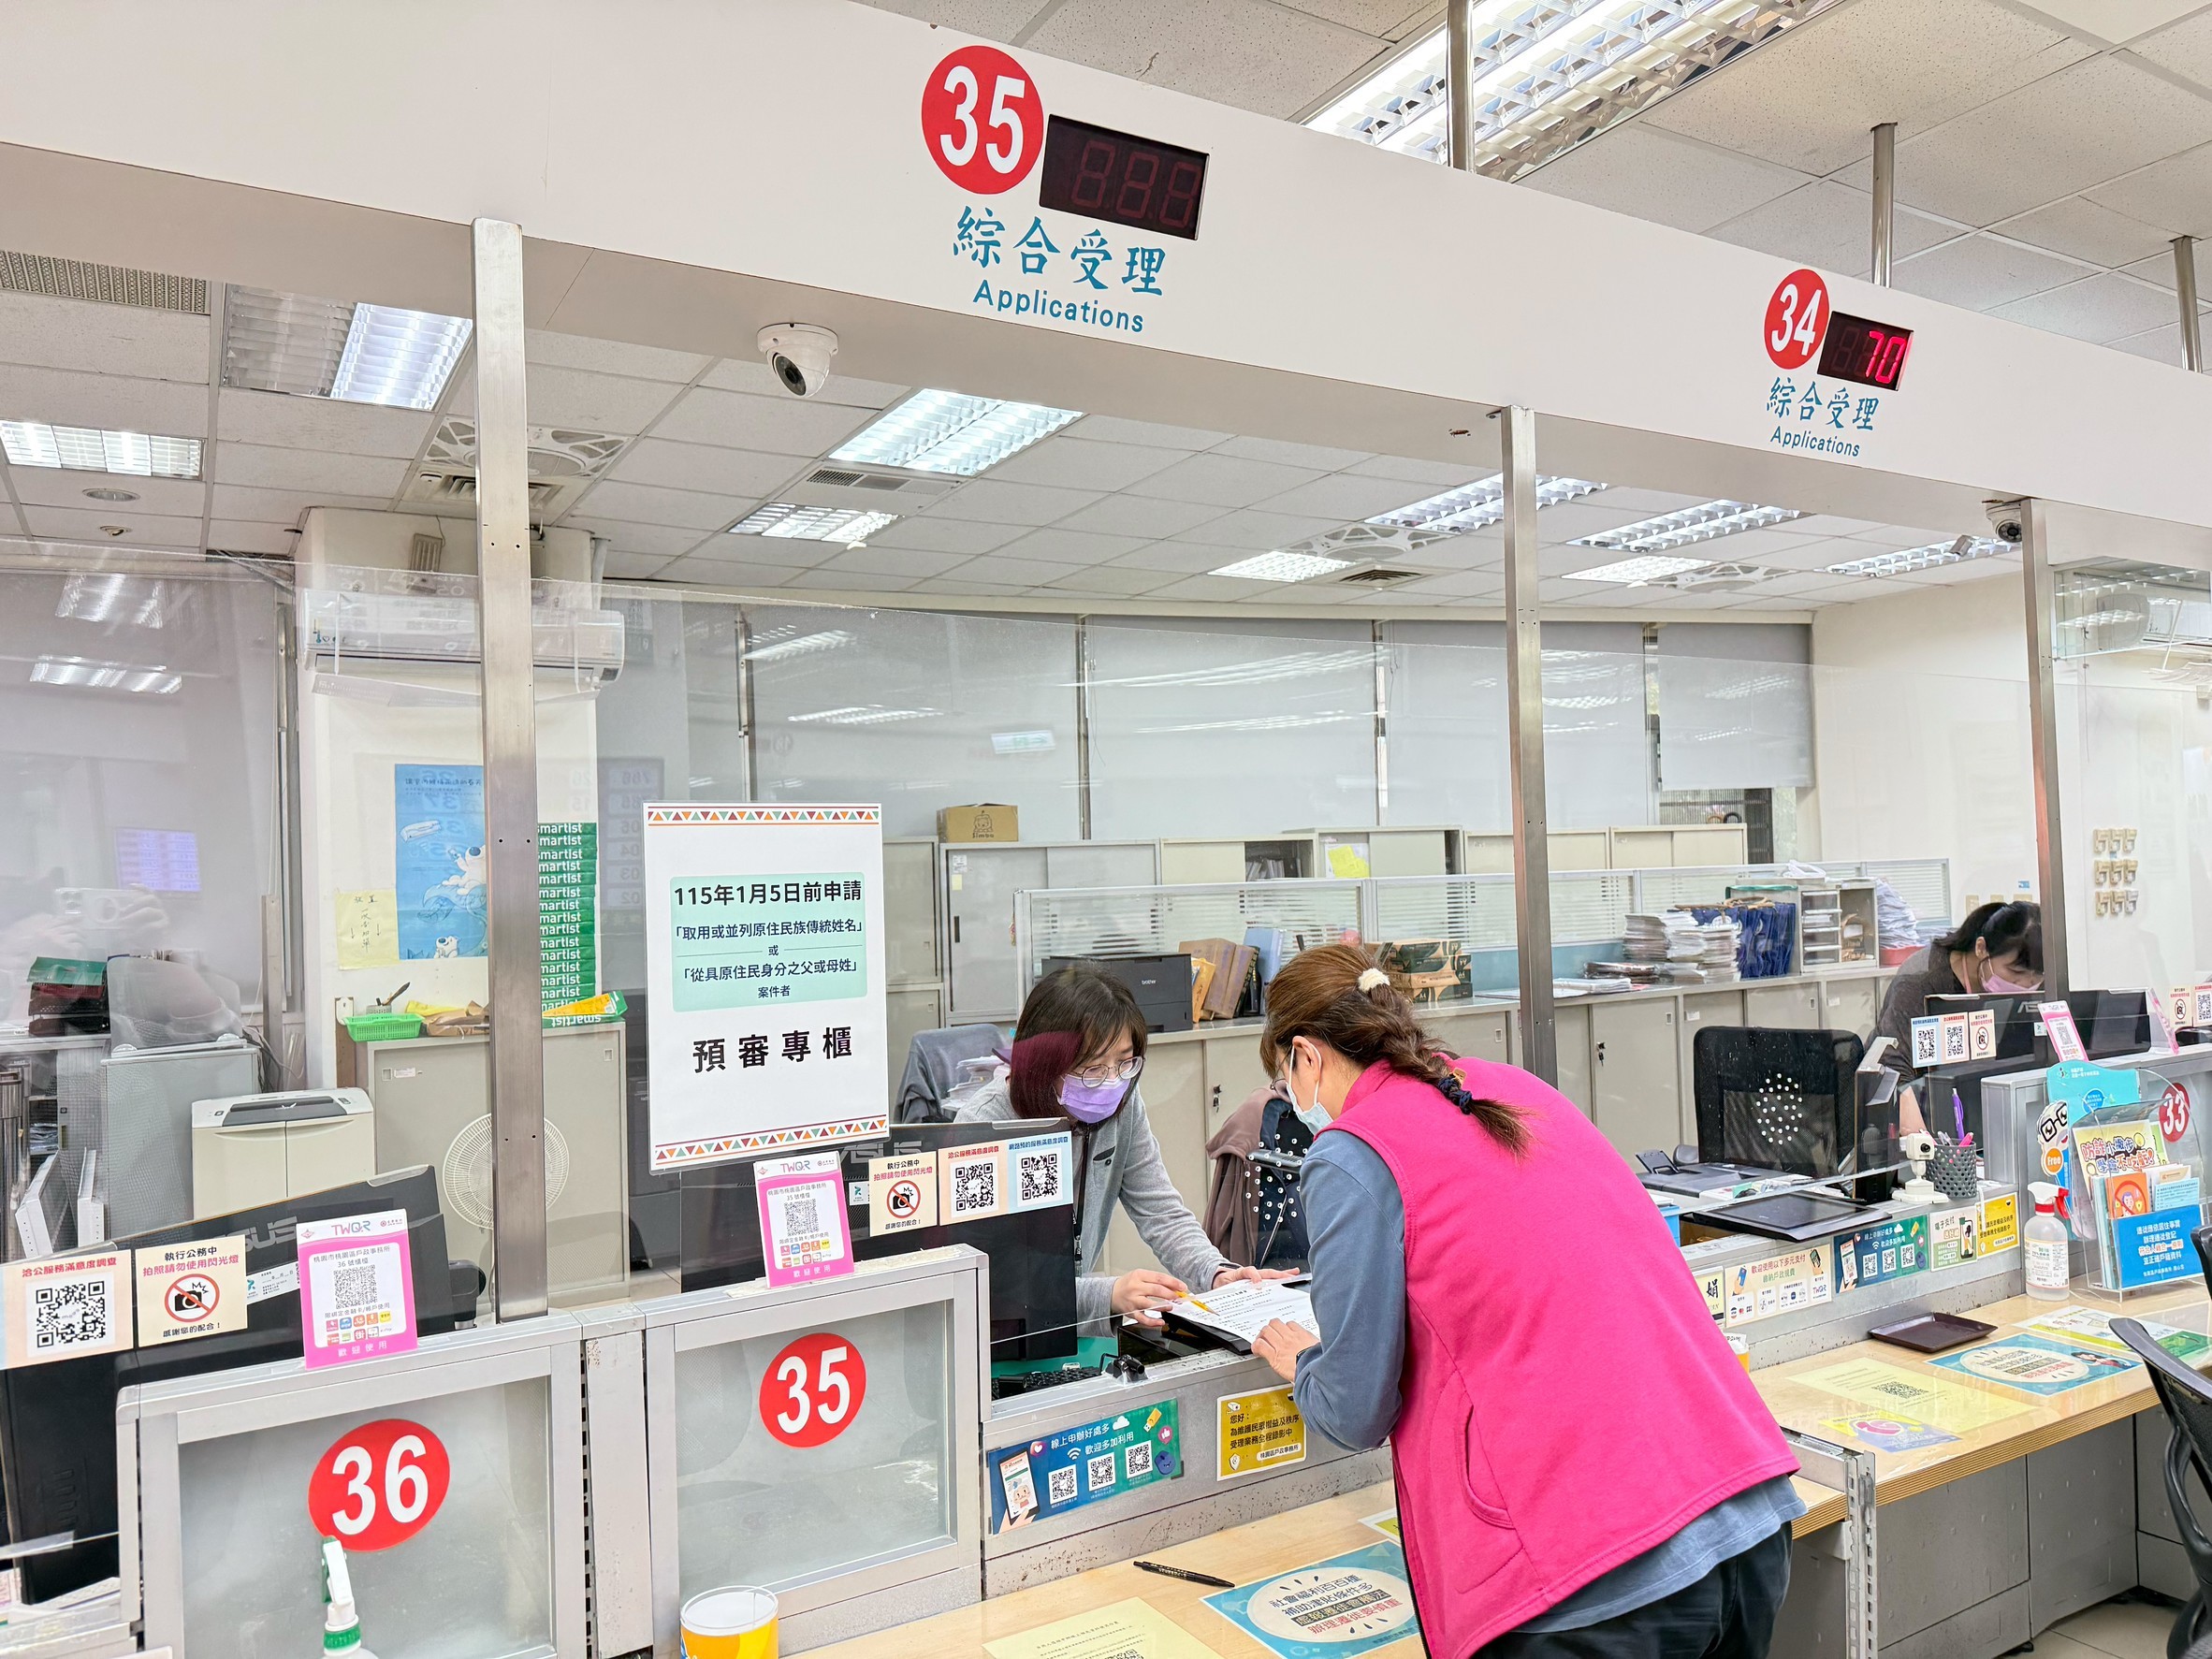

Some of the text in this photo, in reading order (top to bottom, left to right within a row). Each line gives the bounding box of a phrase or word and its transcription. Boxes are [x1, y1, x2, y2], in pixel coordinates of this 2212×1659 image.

[939, 65, 1026, 174] 35
[953, 205, 1166, 296] 綜合受理
[973, 279, 1144, 332] Applications
[1770, 283, 1822, 356] 34
[1865, 330, 1908, 384] 70
[1766, 376, 1880, 430] 綜合受理
[1770, 425, 1860, 457] Applications
[539, 835, 582, 846] martist
[539, 860, 581, 873] martist
[539, 872, 581, 884] martist
[539, 886, 581, 898] martist
[674, 880, 862, 906] 115年1月5日前申請
[539, 898, 580, 910] martist
[539, 910, 581, 924] martist
[540, 923, 580, 936] martist
[676, 918, 863, 940] 「取用或並列原住民族傳統姓名」
[540, 935, 580, 948] martist
[767, 945, 779, 956] 或
[541, 947, 581, 960] martist
[541, 960, 580, 973] martist
[683, 957, 857, 982] 「從具原住民身分之父或母姓」
[541, 973, 580, 986] martist
[541, 985, 580, 998] martist
[757, 985, 791, 998] 案件者
[692, 1026, 852, 1074] 預審專櫃
[2162, 1089, 2187, 1137] 33
[2047, 1156, 2061, 1166] Free
[217, 1216, 298, 1252] SUS
[331, 1220, 371, 1236] TWQR
[165, 1246, 217, 1261] 執行公務中
[22, 1257, 117, 1277] 洽公服務滿意度調查
[142, 1254, 240, 1277] 拍照請勿使用閃光燈
[1706, 1278, 1719, 1299] 娟
[163, 1322, 221, 1338] 感謝您的配合！
[777, 1346, 851, 1434] 35
[1051, 1423, 1110, 1449] 線上申辦好處多
[1084, 1432, 1134, 1455] 歡迎多加利用
[331, 1434, 429, 1535] 36
[1269, 1575, 1363, 1608] 社會福利百百種
